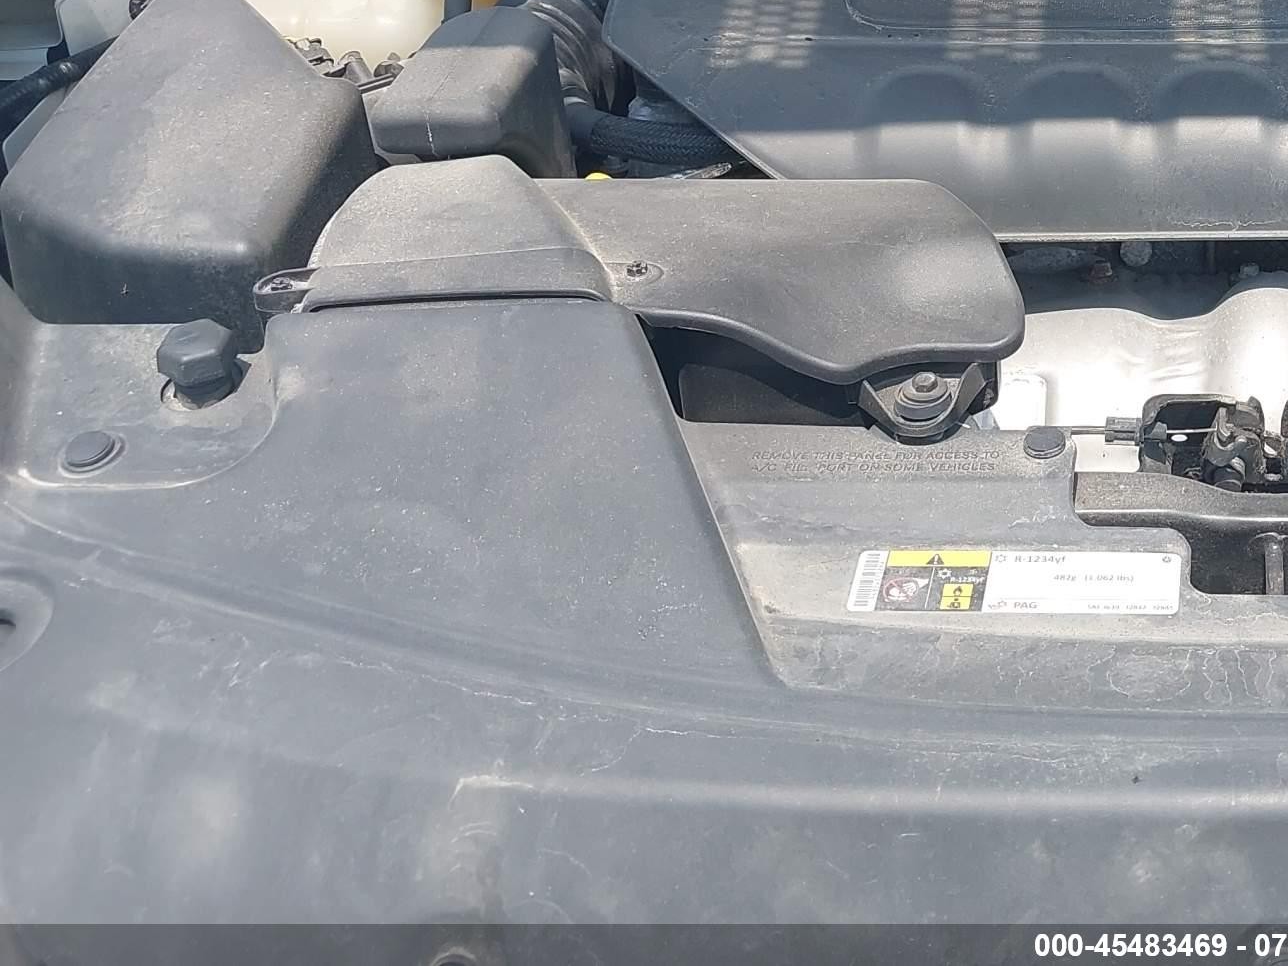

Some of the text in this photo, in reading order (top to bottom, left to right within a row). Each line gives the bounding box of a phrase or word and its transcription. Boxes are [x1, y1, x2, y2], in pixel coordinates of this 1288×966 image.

[752, 451, 809, 460] REMOVE
[815, 451, 843, 460] THIS
[895, 451, 920, 460] FOR
[926, 451, 978, 460] ACCESS
[982, 450, 1000, 460] TO
[752, 463, 777, 472] A/C
[815, 463, 854, 472] PORT
[858, 463, 881, 472] ON
[884, 463, 921, 472] SOME
[929, 462, 995, 472] VEHICLES
[1014, 555, 1066, 564] R-1234yf
[1013, 601, 1038, 610] PAG
